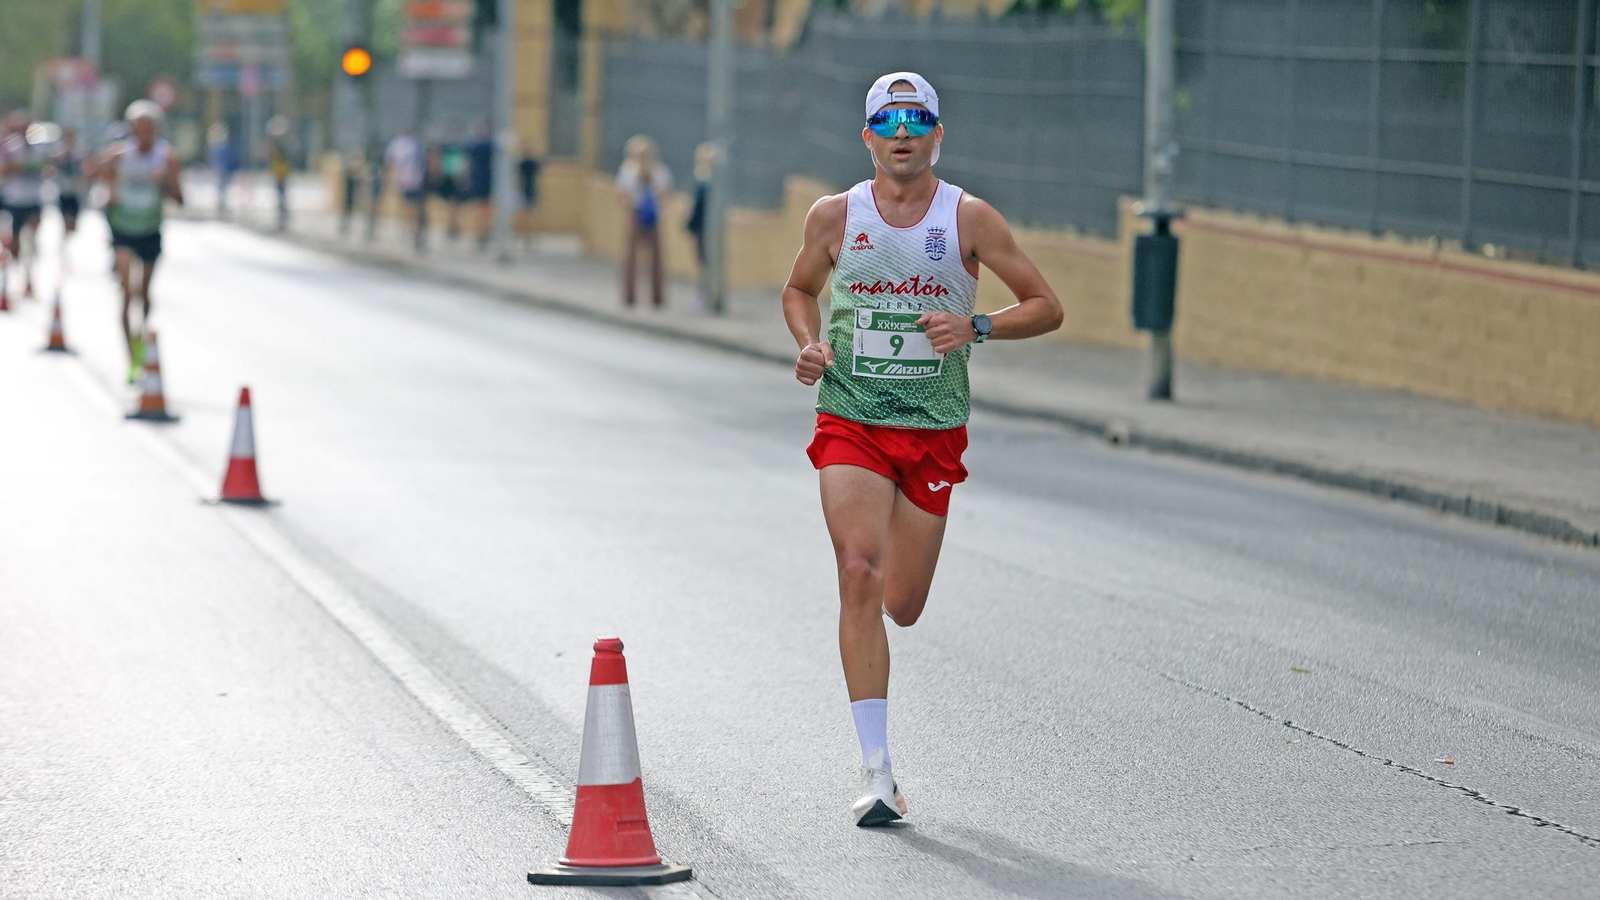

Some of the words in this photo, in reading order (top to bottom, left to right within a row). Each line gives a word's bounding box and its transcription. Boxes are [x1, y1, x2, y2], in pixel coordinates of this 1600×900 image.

[849, 274, 949, 298] maratón
[876, 302, 923, 311] JEREZ
[889, 334, 904, 357] 9
[883, 363, 935, 375] MIZUNO
